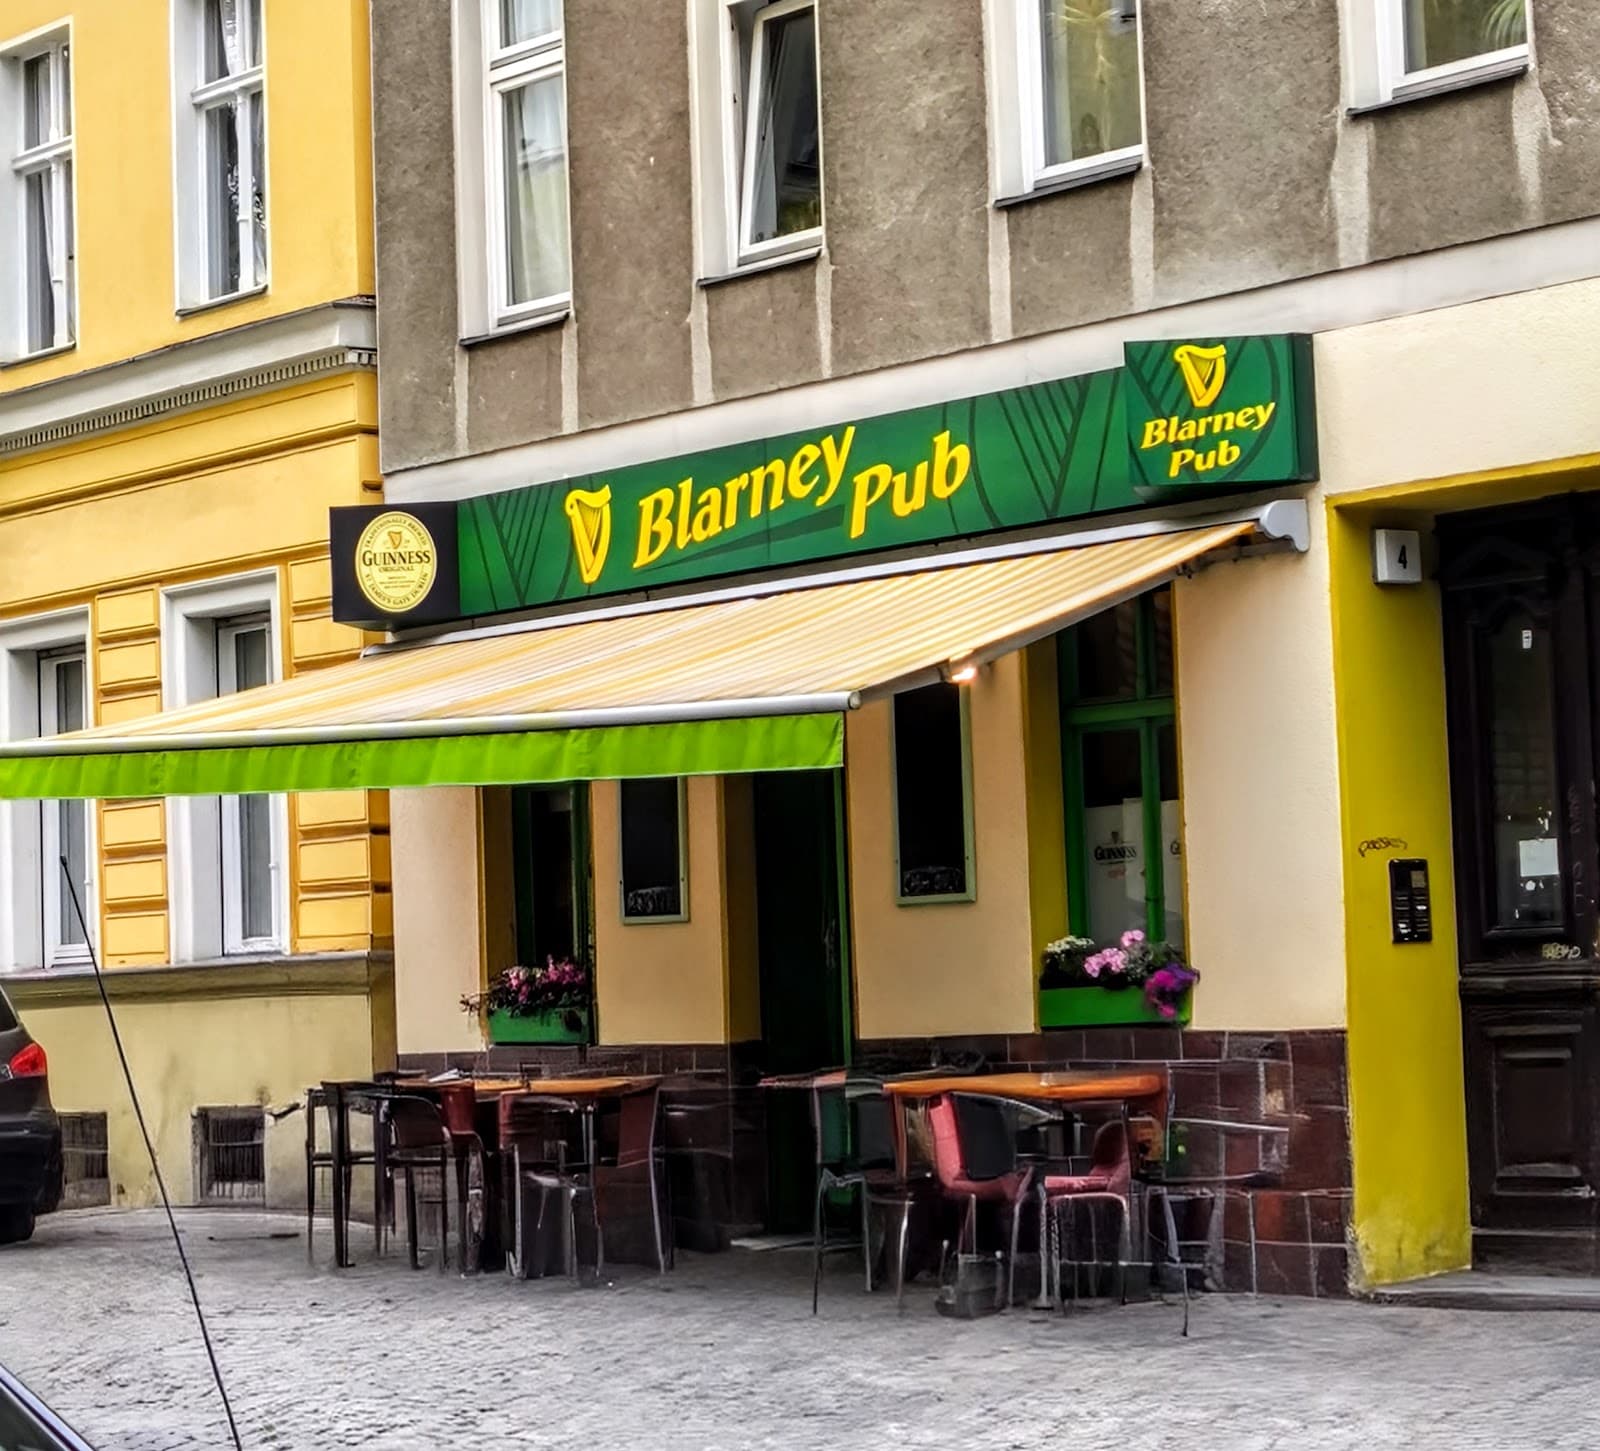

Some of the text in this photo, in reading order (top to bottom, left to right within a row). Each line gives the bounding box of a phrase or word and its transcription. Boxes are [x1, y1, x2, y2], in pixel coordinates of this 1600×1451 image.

[1140, 402, 1276, 449] Blarney
[1168, 440, 1241, 478] Pub
[632, 426, 971, 569] Blarney Pub
[362, 550, 431, 567] GUINNESS
[1397, 545, 1408, 569] 4
